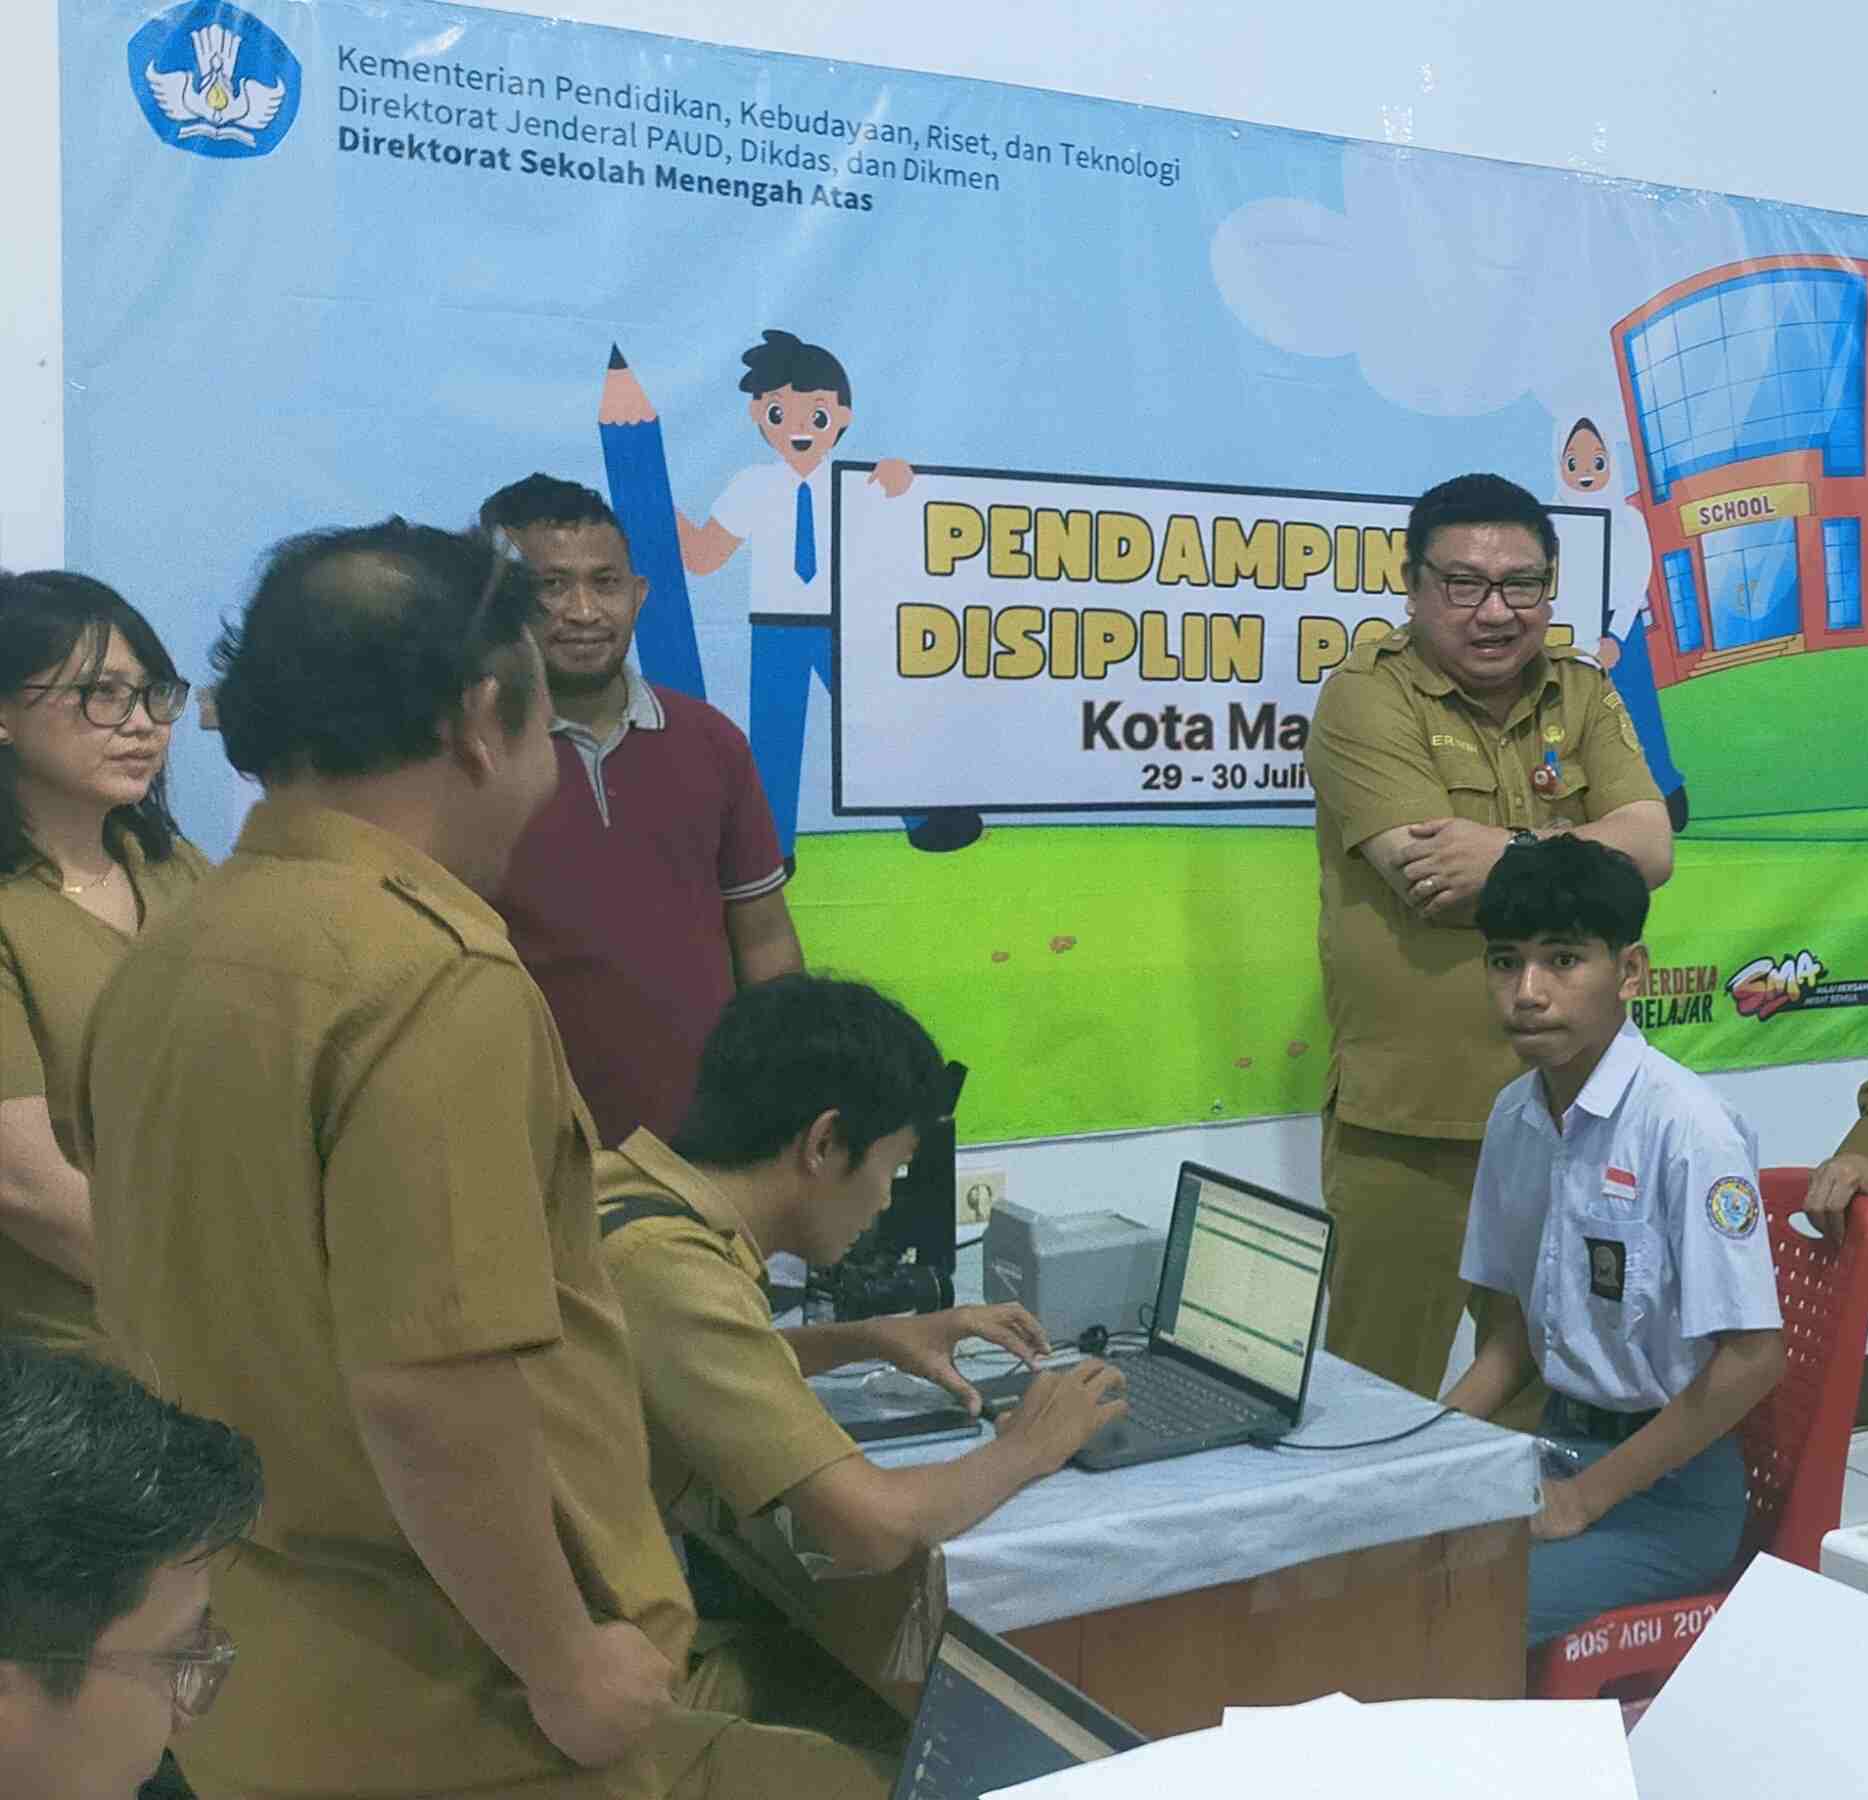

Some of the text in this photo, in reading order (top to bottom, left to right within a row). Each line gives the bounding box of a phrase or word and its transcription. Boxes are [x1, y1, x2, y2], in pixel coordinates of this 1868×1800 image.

[338, 44, 1182, 186] Kementerian Pendidikan, Kebudayaan, Riset, dan Teknologi
[339, 86, 1000, 191] Direktorat Jenderal PAUD, Dikdas, dan Dikmen
[338, 126, 873, 212] Direktorat Sekolah Menengah Atas
[1699, 495, 1776, 526] SCHOOL
[924, 502, 1560, 600] PENDAMPIN
[896, 603, 1265, 683] DISIPLIN
[1082, 700, 1214, 752] Kota
[1141, 763, 1183, 790] 29
[1211, 763, 1247, 790] 30
[1253, 763, 1305, 790] Juli
[1631, 994, 1713, 1029] BELAJAR
[1643, 965, 1718, 996] ERDEKA
